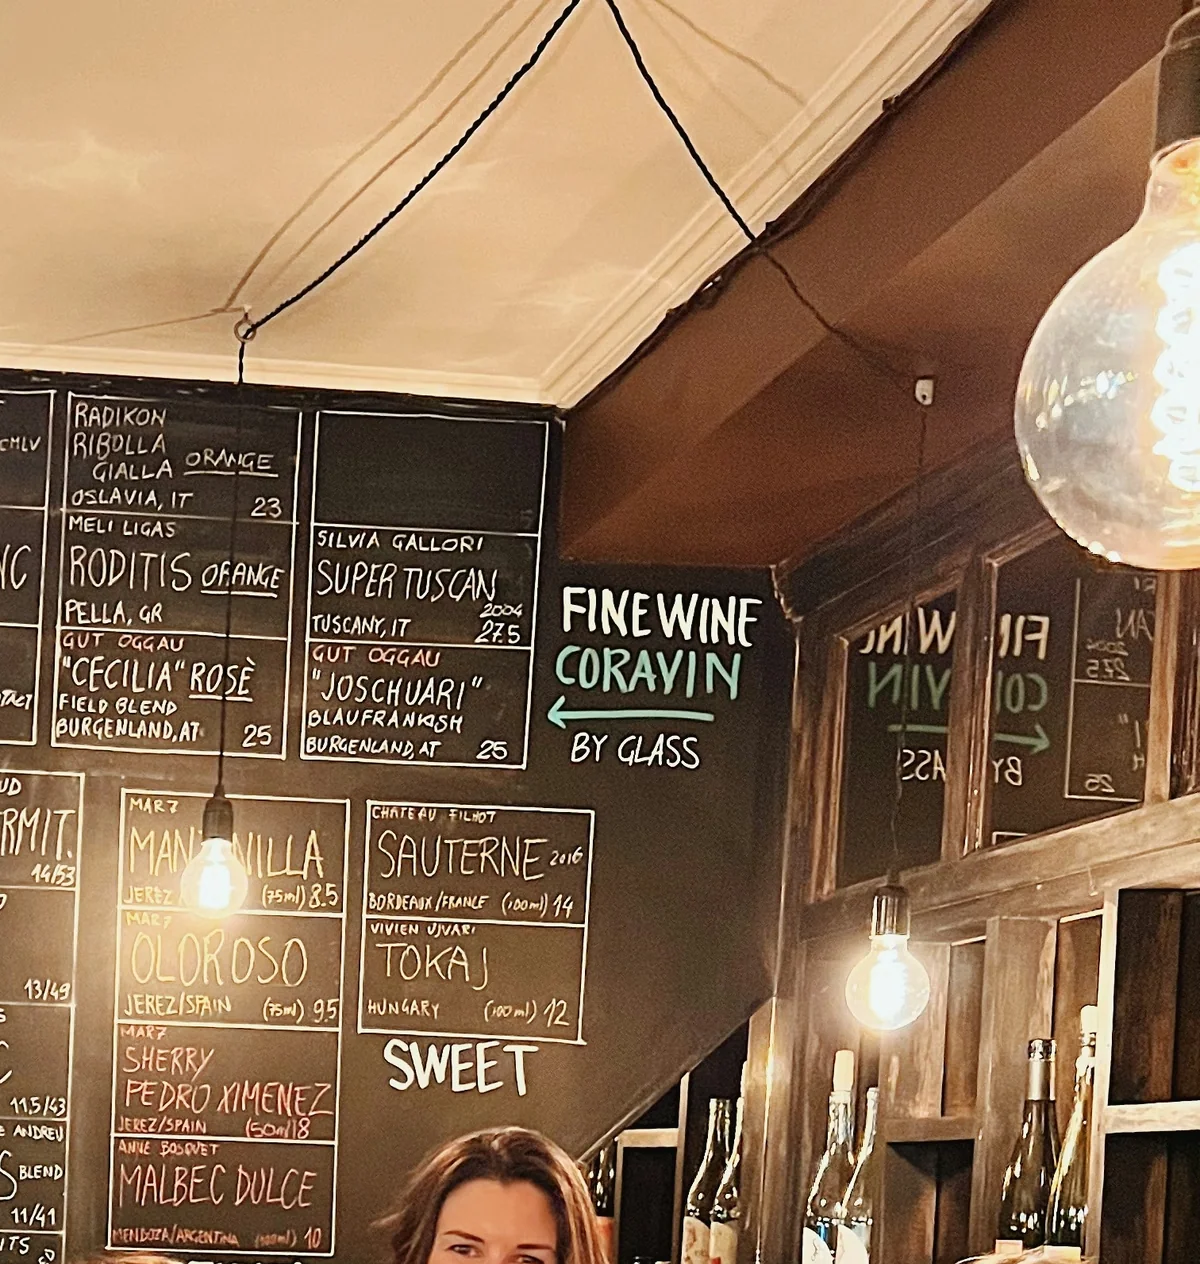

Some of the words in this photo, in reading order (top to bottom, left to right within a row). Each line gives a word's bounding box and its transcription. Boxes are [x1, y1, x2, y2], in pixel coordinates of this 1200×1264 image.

[74, 401, 167, 428] RADIKON
[73, 431, 168, 460] RIBOLLA
[92, 458, 174, 483] GIALLA
[186, 447, 274, 471] ORANGE
[172, 492, 194, 509] IT
[250, 496, 283, 518] 23
[69, 515, 113, 534] MELI
[123, 519, 177, 538] LIGAS
[316, 529, 381, 551] SILVIA
[391, 533, 485, 553] GALLORI
[70, 544, 193, 593] RODITIS
[316, 559, 398, 600] SUPER
[403, 566, 498, 602] TUSCAN
[65, 599, 133, 626] PELLA,
[562, 585, 650, 638] FINE
[656, 594, 763, 647] WINE
[62, 631, 104, 649] GUT
[117, 632, 185, 652] OGGAU
[311, 644, 356, 664] GUT
[368, 647, 441, 668] OGGAU
[62, 656, 186, 694] "CECILIA"
[554, 645, 743, 701] CORAVIN
[311, 668, 484, 711] "JOSCHUARI"
[58, 692, 109, 714] FIELD
[115, 696, 178, 716] BLEND
[241, 724, 273, 748] 25
[476, 740, 508, 760] 25
[570, 731, 607, 763] BY
[616, 733, 701, 770] GLASS
[377, 829, 549, 881] SAUTERNE
[308, 883, 339, 909] 8.5
[552, 894, 574, 919] 14
[370, 922, 420, 936] VIVIEN
[131, 928, 308, 988] OLOROSO
[375, 942, 489, 991] TOKAJ
[23, 978, 71, 1001] 13/49
[367, 998, 440, 1019] HUNGARY
[543, 998, 571, 1028] 12
[122, 1046, 215, 1082] SHERRY
[382, 1038, 540, 1097] SWEET
[125, 1078, 211, 1114] PEDRO
[216, 1080, 334, 1117] XIMENEZ
[18, 1164, 63, 1181] BLEND
[118, 1163, 226, 1209] MALBEC
[234, 1164, 318, 1210] DULCE
[10, 1202, 57, 1228] 11/41
[304, 1226, 323, 1250] 10
